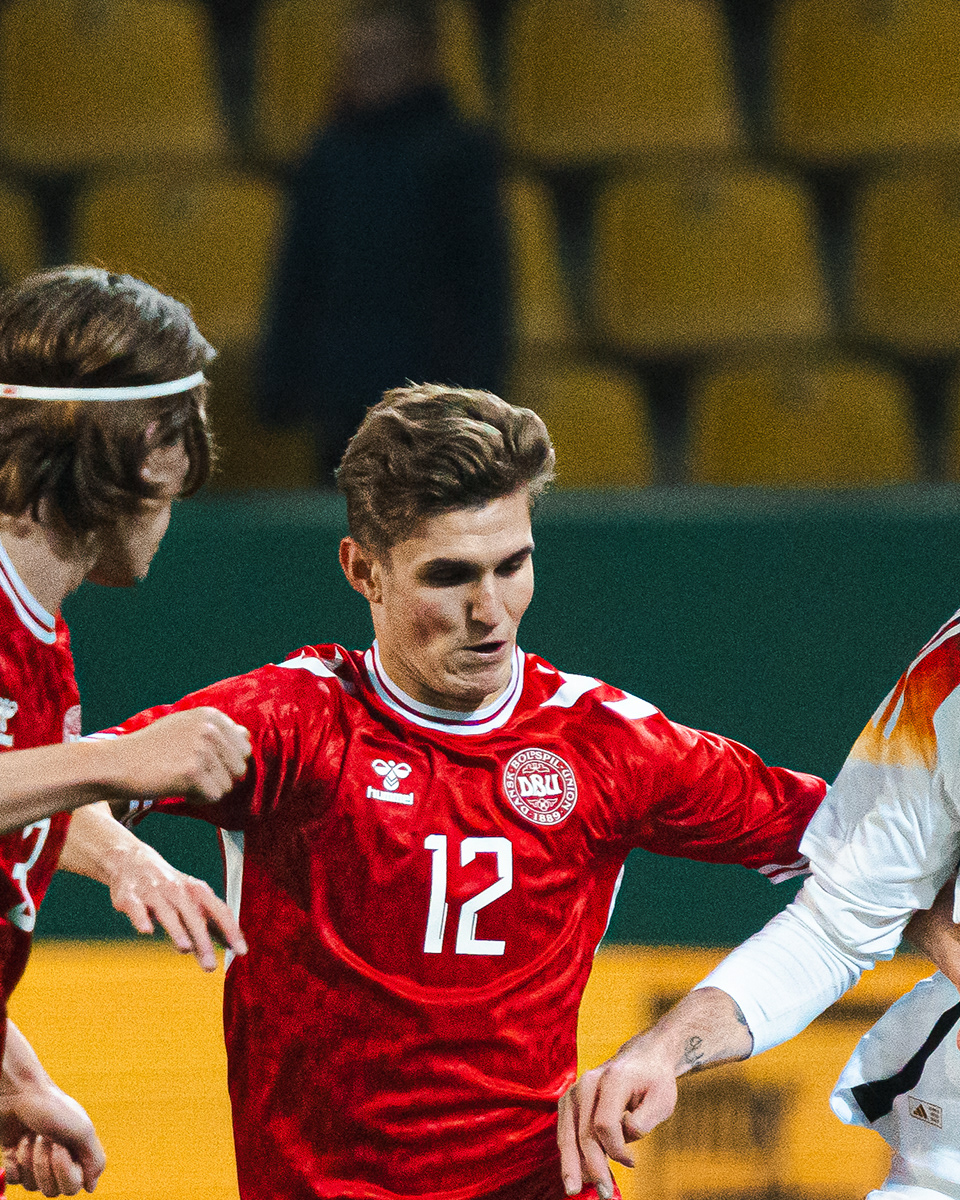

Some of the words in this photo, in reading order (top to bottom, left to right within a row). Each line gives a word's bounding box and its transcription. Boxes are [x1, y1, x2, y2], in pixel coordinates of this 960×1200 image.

[366, 785, 414, 806] hummel
[506, 771, 530, 815] DANSK
[562, 769, 575, 811] UNION
[517, 773, 563, 798] DBU
[533, 811, 561, 823] 1889
[423, 833, 514, 956] 12
